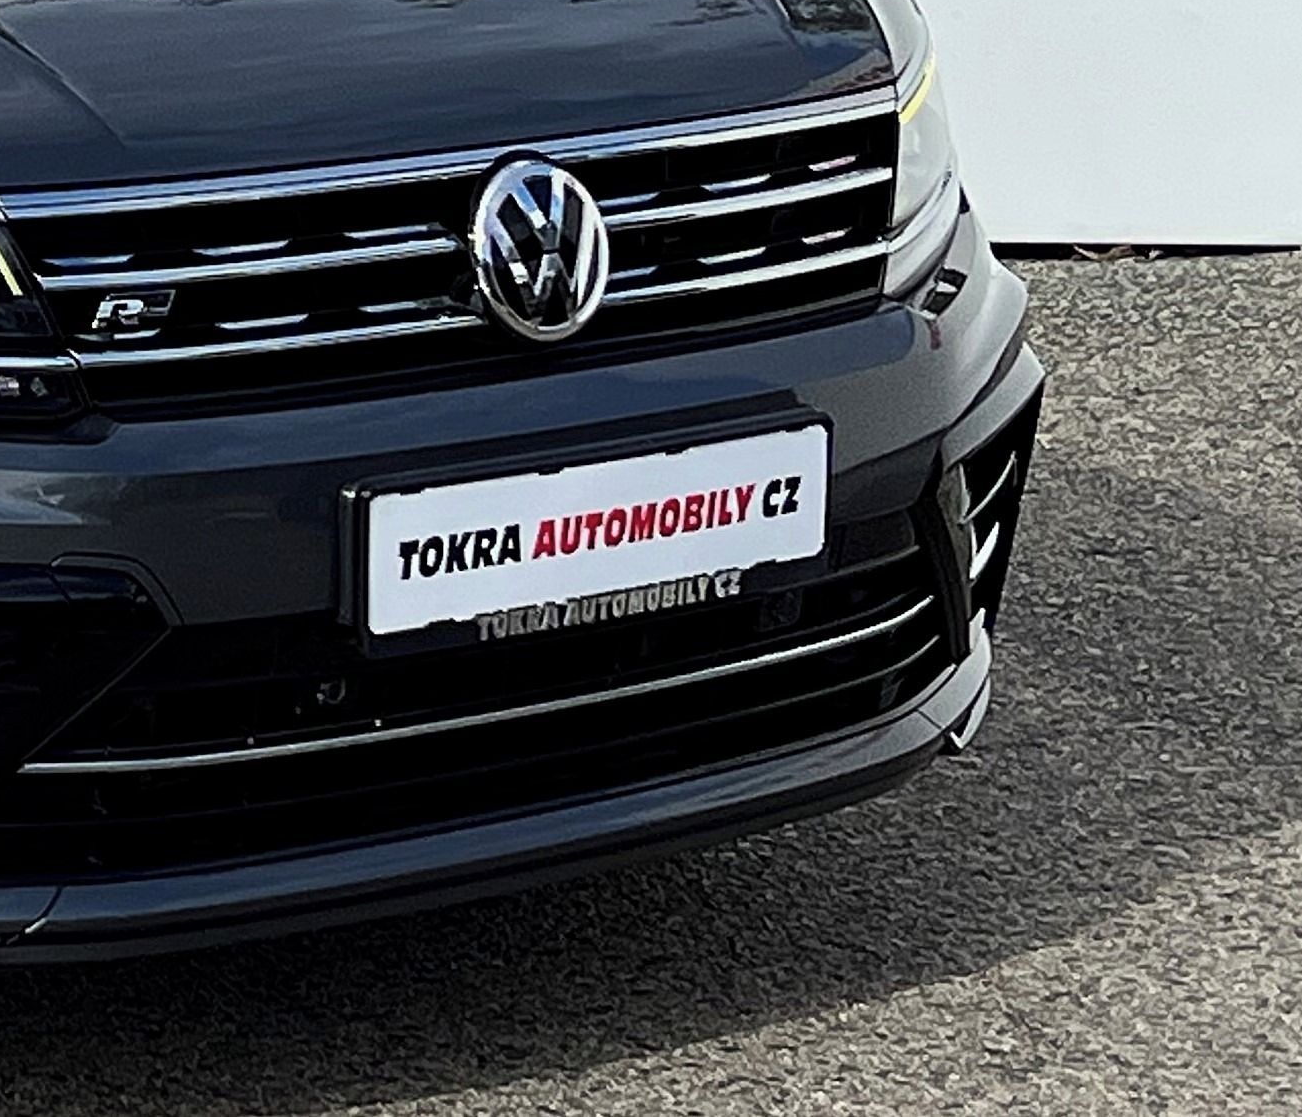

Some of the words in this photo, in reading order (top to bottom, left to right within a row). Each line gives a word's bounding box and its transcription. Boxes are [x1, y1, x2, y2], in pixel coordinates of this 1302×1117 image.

[398, 523, 522, 581] TOKRA
[531, 483, 756, 561] AUTOMOBILY
[761, 475, 803, 519] CZ
[477, 600, 560, 642] TOKRA
[563, 574, 709, 630] AUTOMOBILY
[713, 567, 743, 601] CZ
